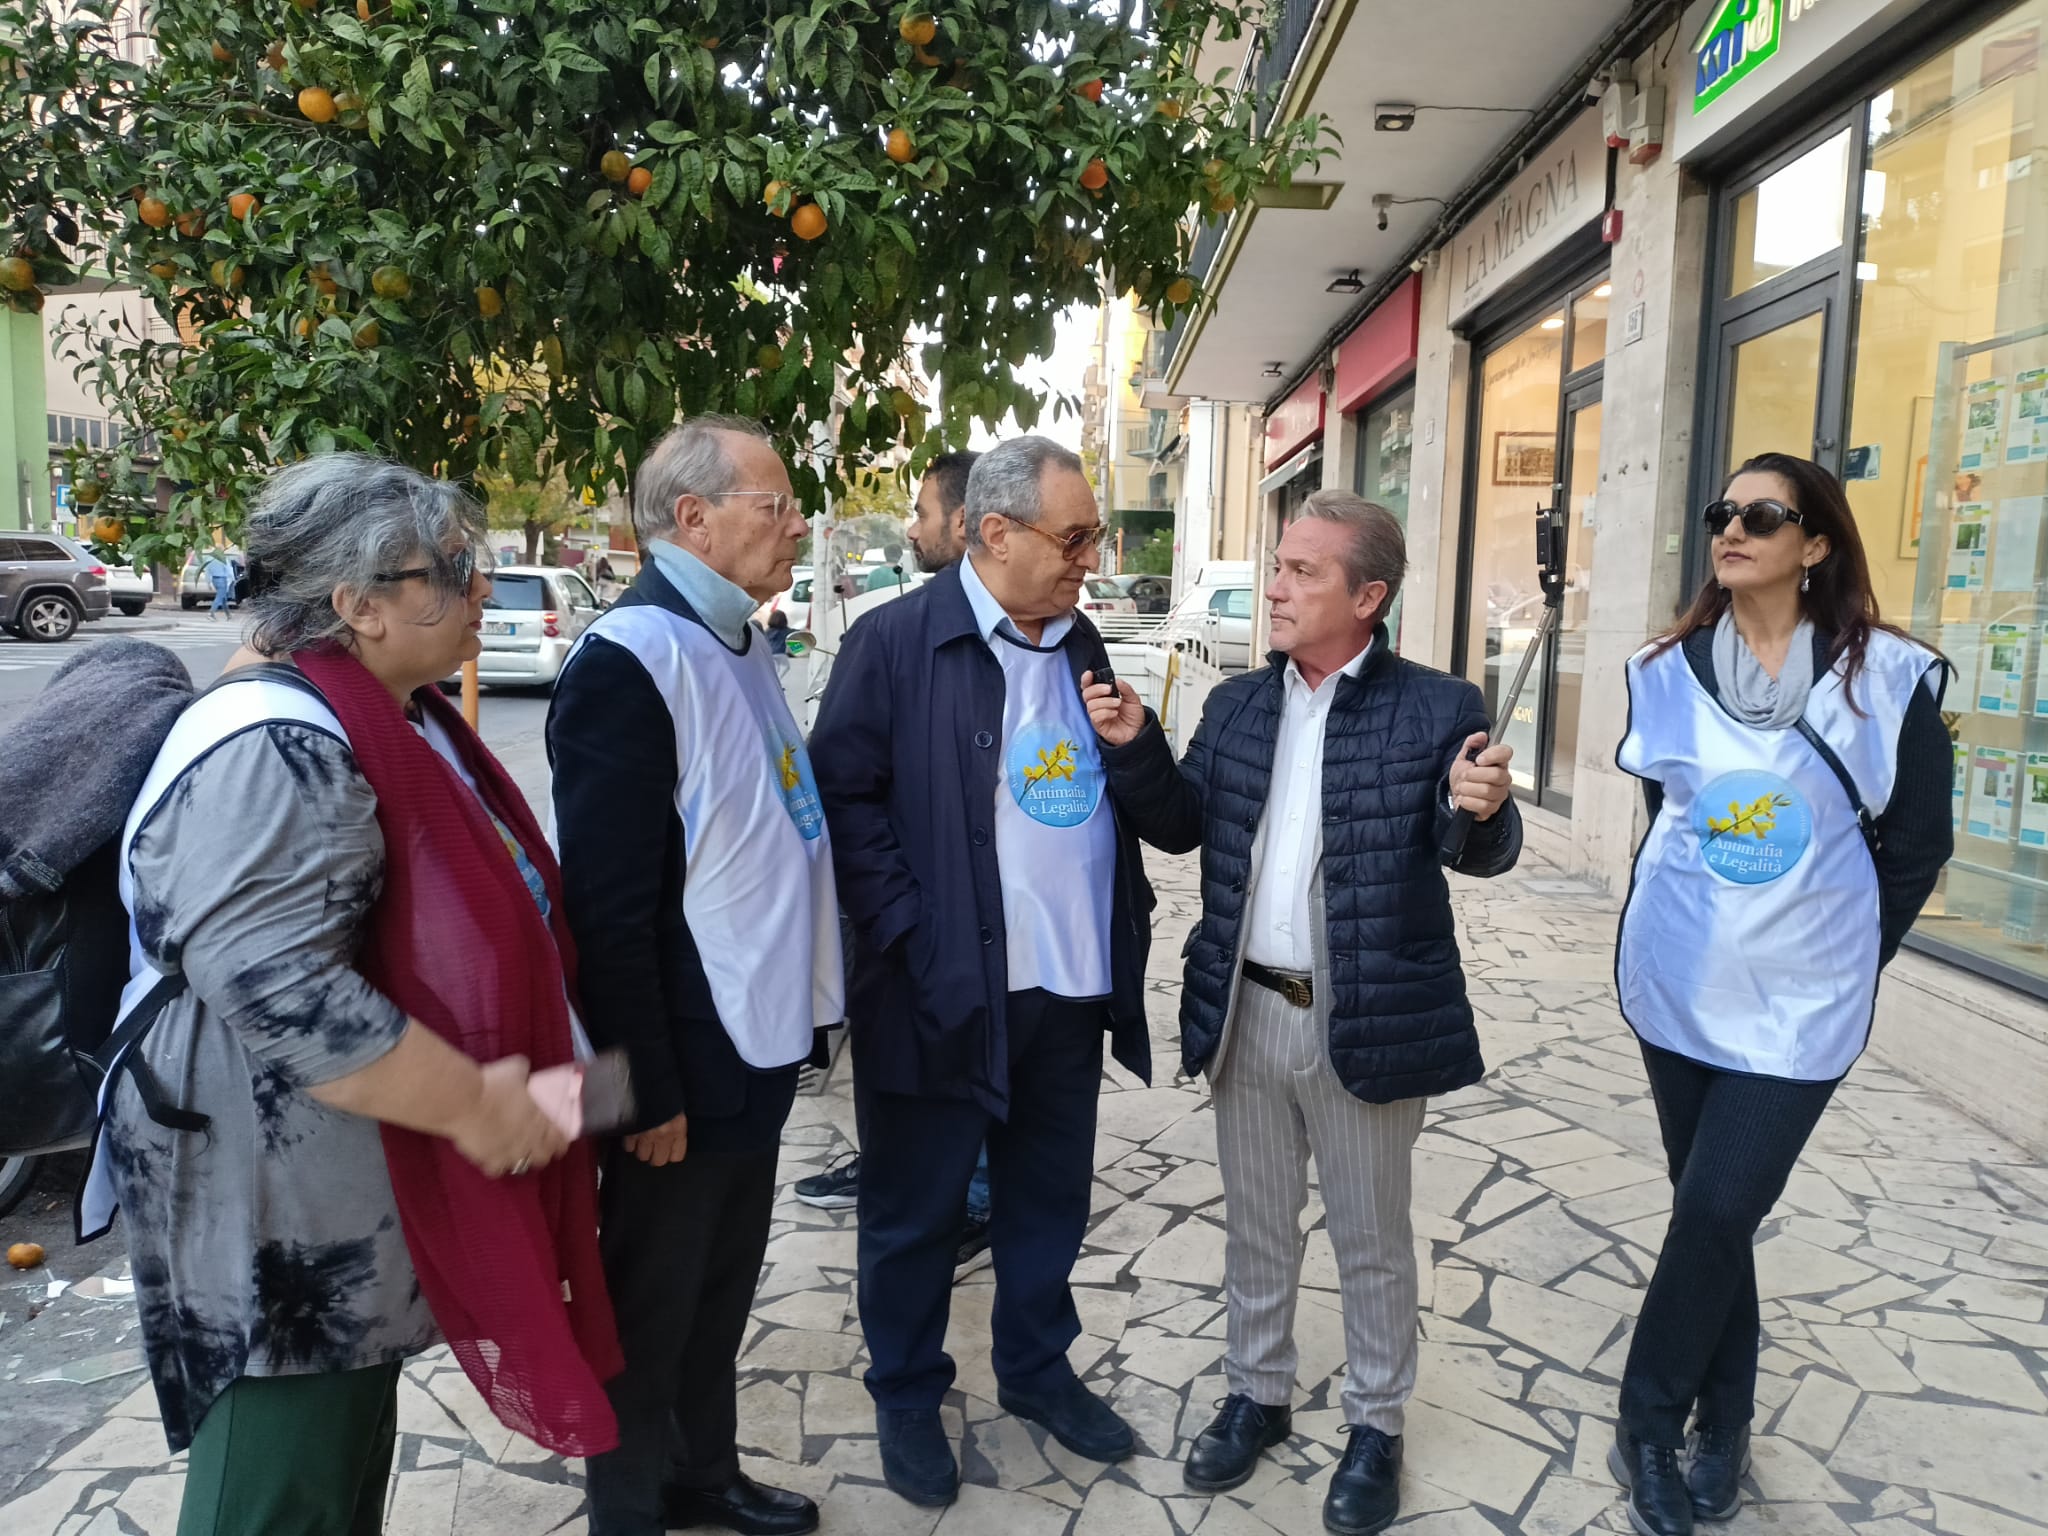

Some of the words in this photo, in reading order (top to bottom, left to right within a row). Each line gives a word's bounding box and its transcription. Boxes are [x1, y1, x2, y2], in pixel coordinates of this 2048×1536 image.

[1464, 233, 1488, 293] LA
[1027, 785, 1087, 800] Antimafia
[1029, 805, 1037, 815] e
[1041, 800, 1090, 818] Legalità
[1711, 838, 1784, 858] Antimafia
[1708, 854, 1718, 863] e
[1720, 851, 1783, 874] Legalità
